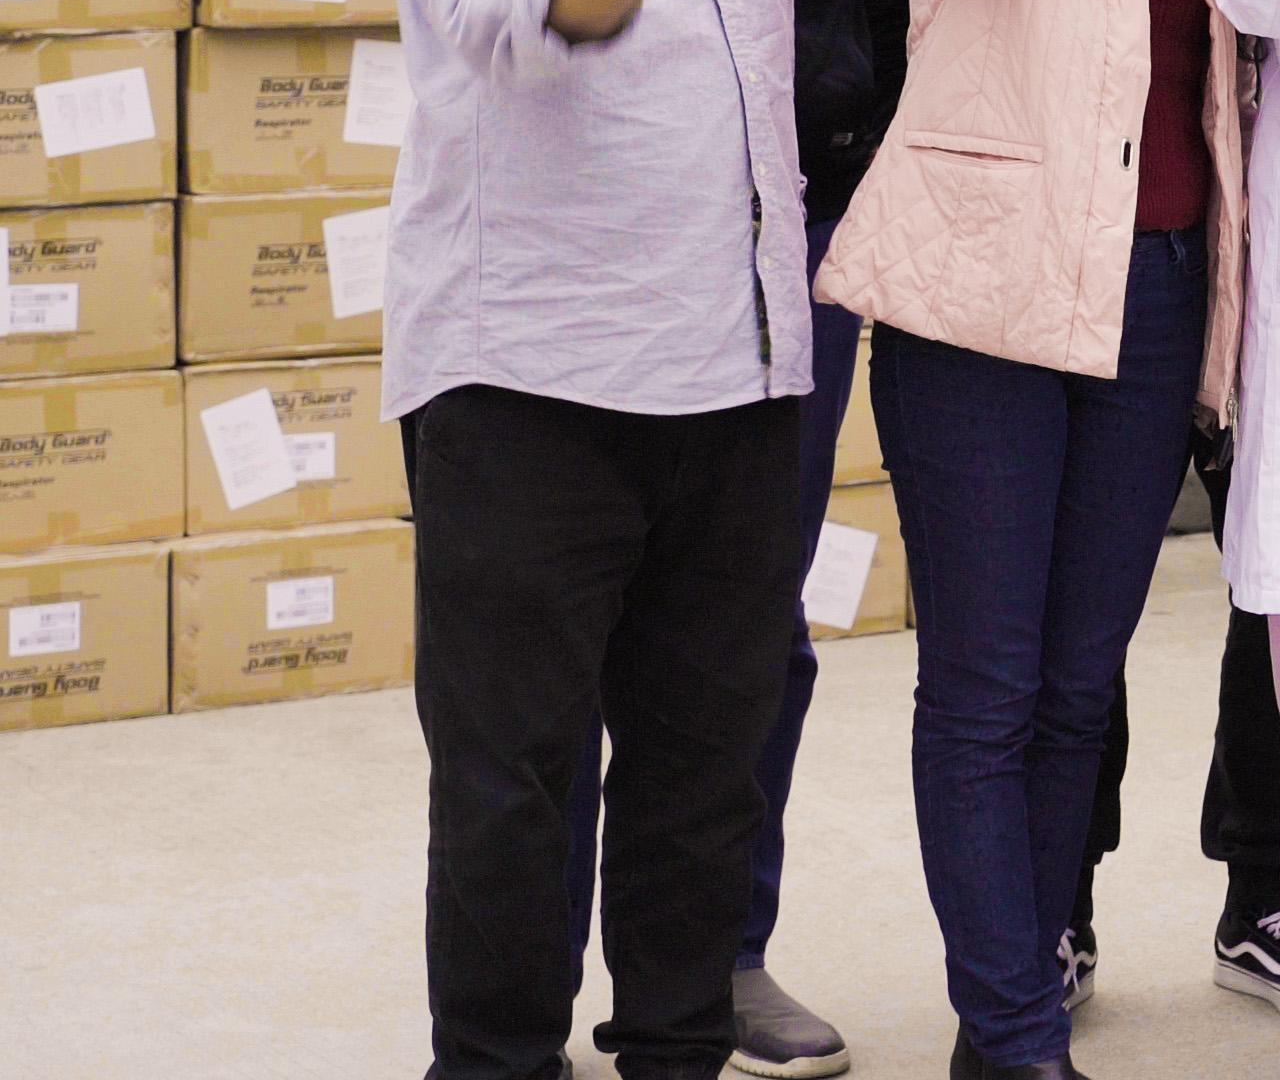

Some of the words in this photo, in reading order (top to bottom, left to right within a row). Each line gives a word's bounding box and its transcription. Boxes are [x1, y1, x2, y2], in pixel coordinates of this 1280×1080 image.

[259, 76, 304, 97] Body
[308, 77, 348, 91] Guar
[317, 99, 347, 107] GEA
[41, 240, 97, 257] Guard
[257, 245, 302, 264] Body
[52, 431, 107, 448] Guard
[304, 647, 348, 664] Body
[54, 674, 101, 697] Body
